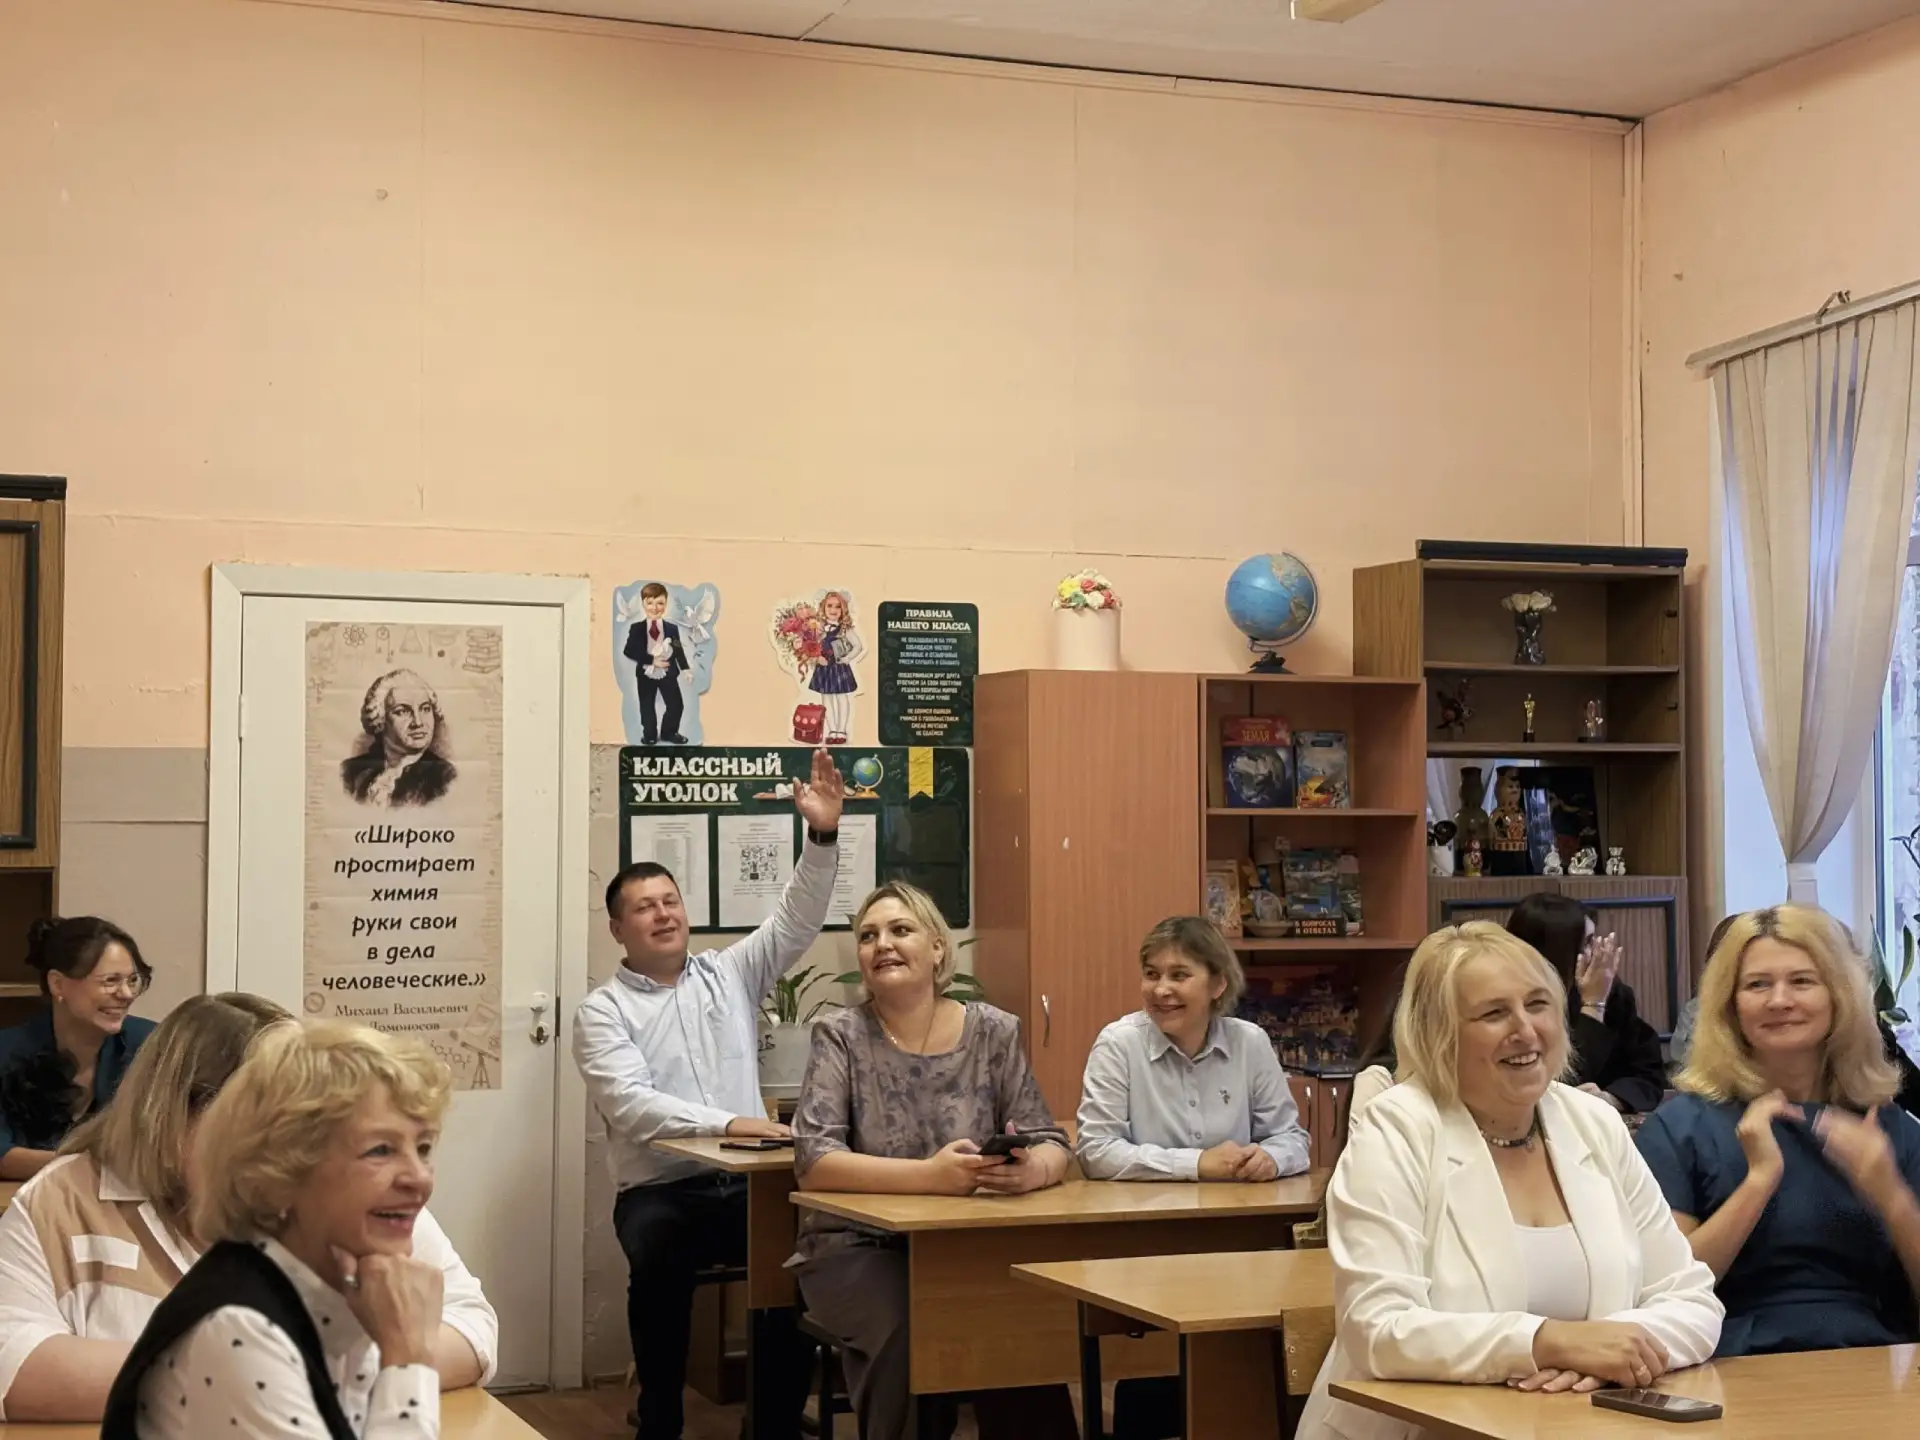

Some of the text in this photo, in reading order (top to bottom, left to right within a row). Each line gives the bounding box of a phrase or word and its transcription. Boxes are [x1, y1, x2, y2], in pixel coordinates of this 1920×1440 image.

[906, 609, 953, 618] ПРАВИЛА
[887, 621, 971, 630] НАШЕГО КЛАССА
[1242, 730, 1270, 742] ЗЕМЛЯ
[633, 753, 783, 776] КЛАССНЫЙ
[633, 782, 738, 803] УГОЛОК
[355, 825, 455, 848] «Широко
[334, 857, 475, 878] простирает
[371, 887, 438, 901] химия
[352, 915, 457, 937] руки свои
[367, 945, 435, 964] в дела
[322, 972, 486, 990] человеческие.»
[335, 1003, 468, 1016] Михаил Васильевич
